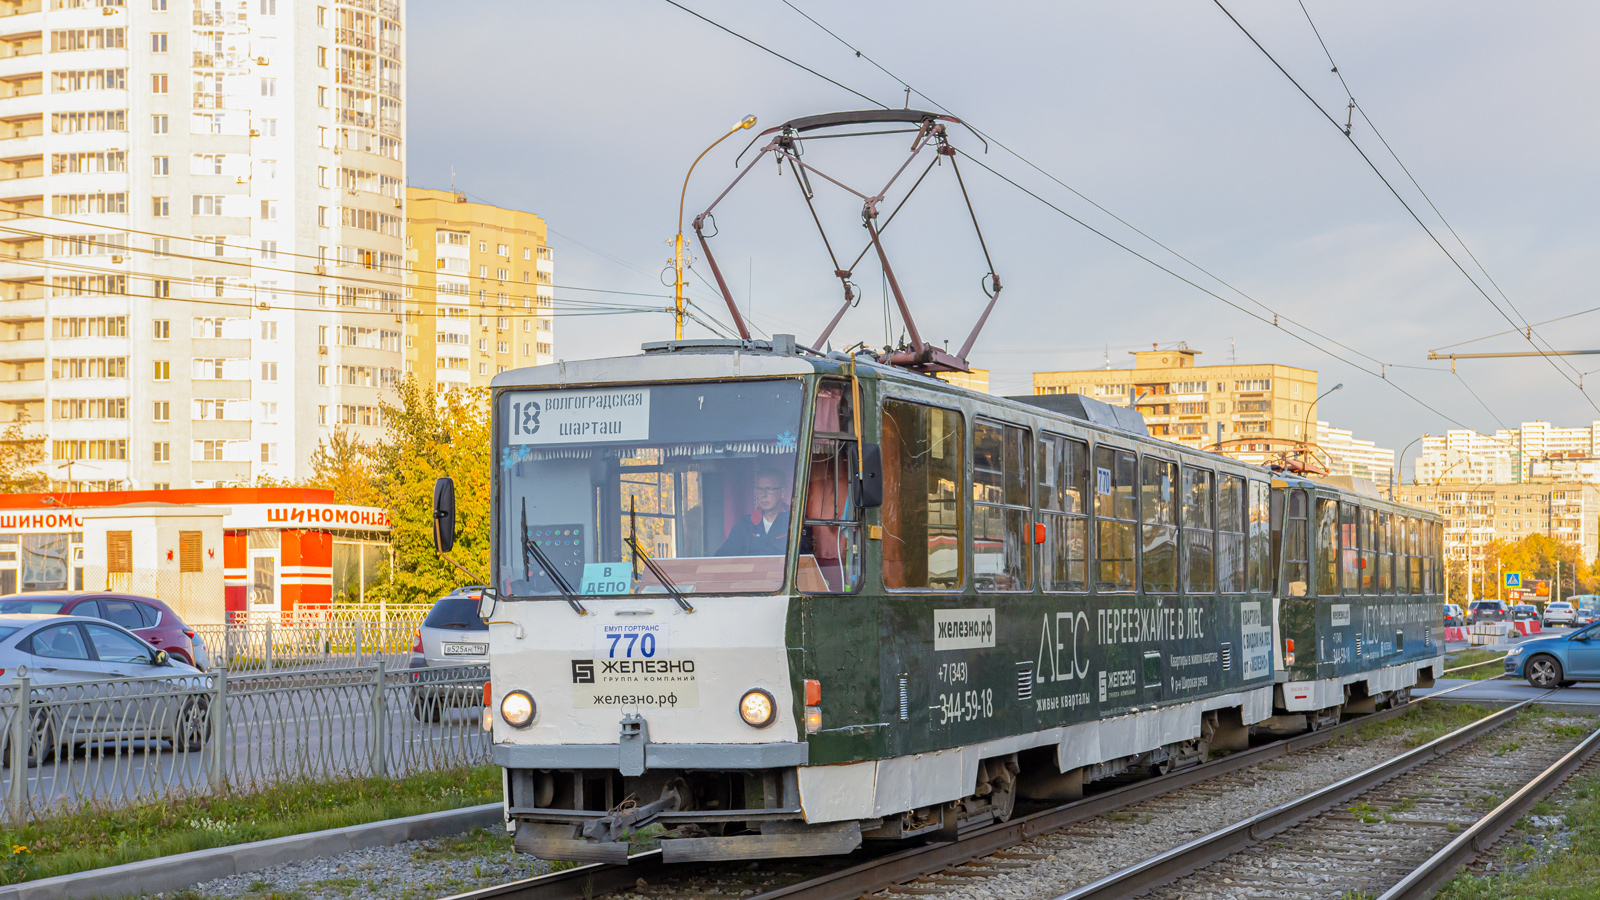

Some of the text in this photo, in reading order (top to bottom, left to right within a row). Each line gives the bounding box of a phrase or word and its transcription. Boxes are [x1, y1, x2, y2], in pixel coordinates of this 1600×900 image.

[513, 401, 541, 435] 18
[1098, 469, 1110, 493] 770
[603, 567, 612, 577] В
[585, 582, 626, 595] ДЕПО
[938, 615, 993, 643] железно.рф
[1098, 599, 1204, 645] ПЕРЕЕЗЖАЙТЕ В ЛЕС
[606, 633, 655, 658] 770
[1036, 611, 1090, 683] ЛЕС
[601, 660, 695, 673] ЖЕЛЕЗНО
[938, 662, 968, 685] +7 (343)
[1108, 670, 1136, 688] ЖЕЛЕЗНО
[593, 692, 678, 707] железно.рф
[939, 688, 993, 725] 344-59-18
[1036, 696, 1059, 712] живые
[1060, 692, 1090, 711] кварталы
